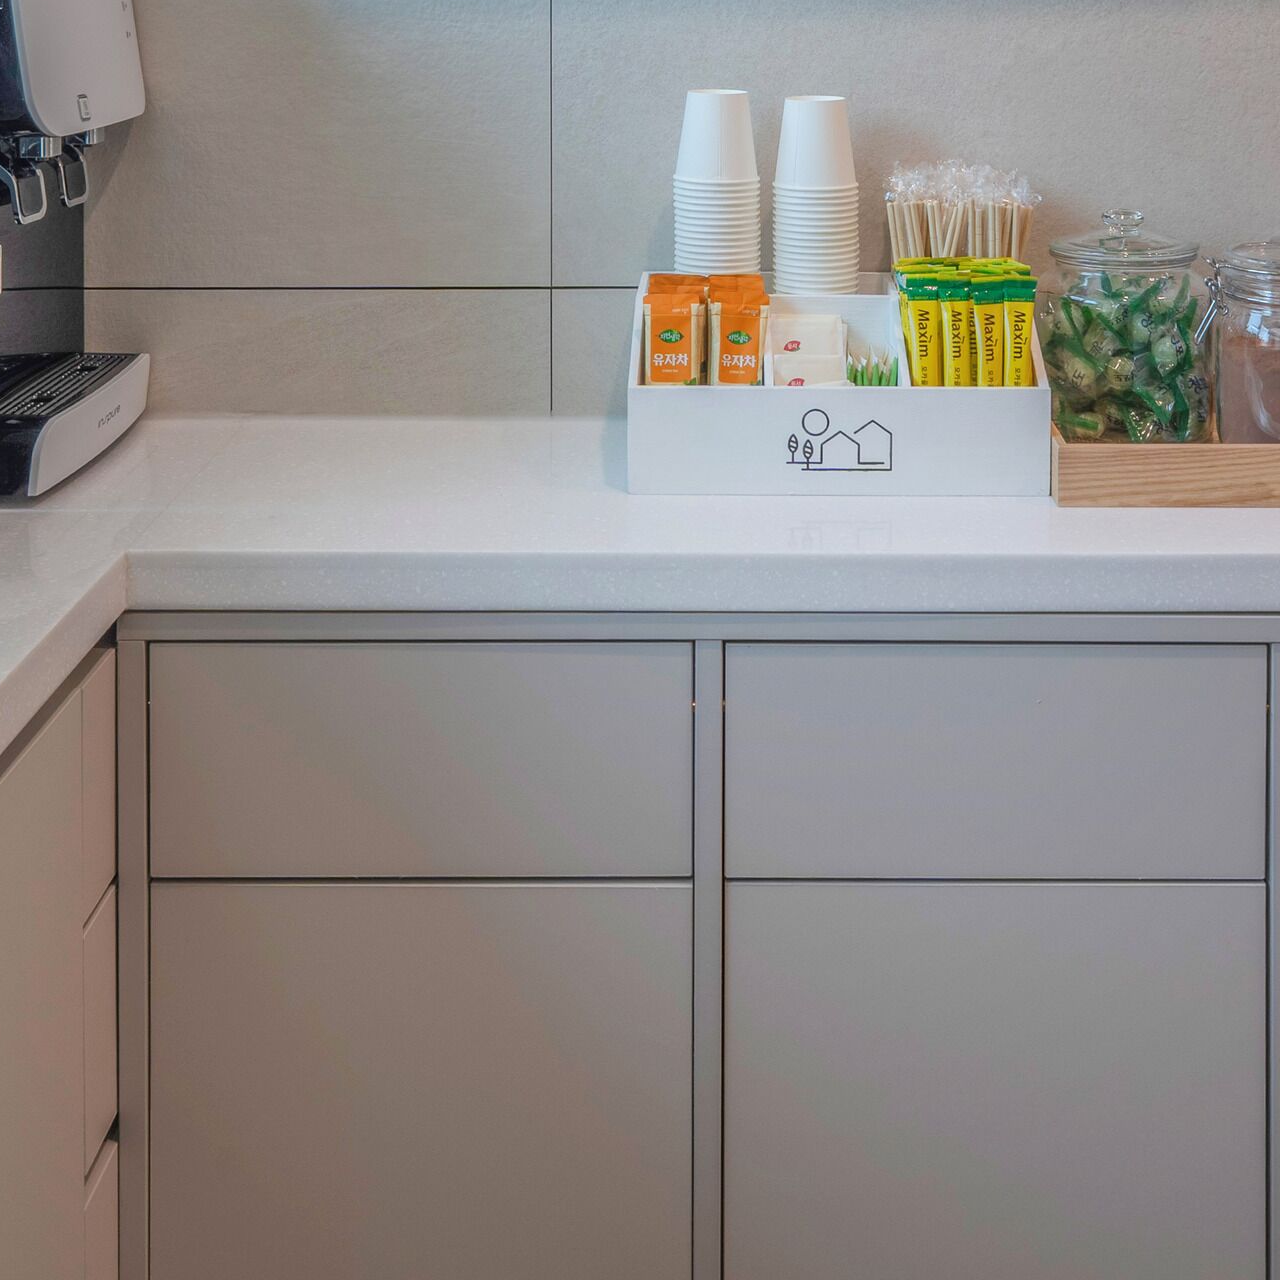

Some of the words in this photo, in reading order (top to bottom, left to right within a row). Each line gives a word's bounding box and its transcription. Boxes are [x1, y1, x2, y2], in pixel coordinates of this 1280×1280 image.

[917, 308, 933, 359] Maxim
[950, 309, 966, 360] Maxim
[983, 312, 999, 363] Maxim
[1013, 309, 1028, 360] Maxim
[652, 353, 689, 367] 유자차
[721, 353, 757, 369] 유자차
